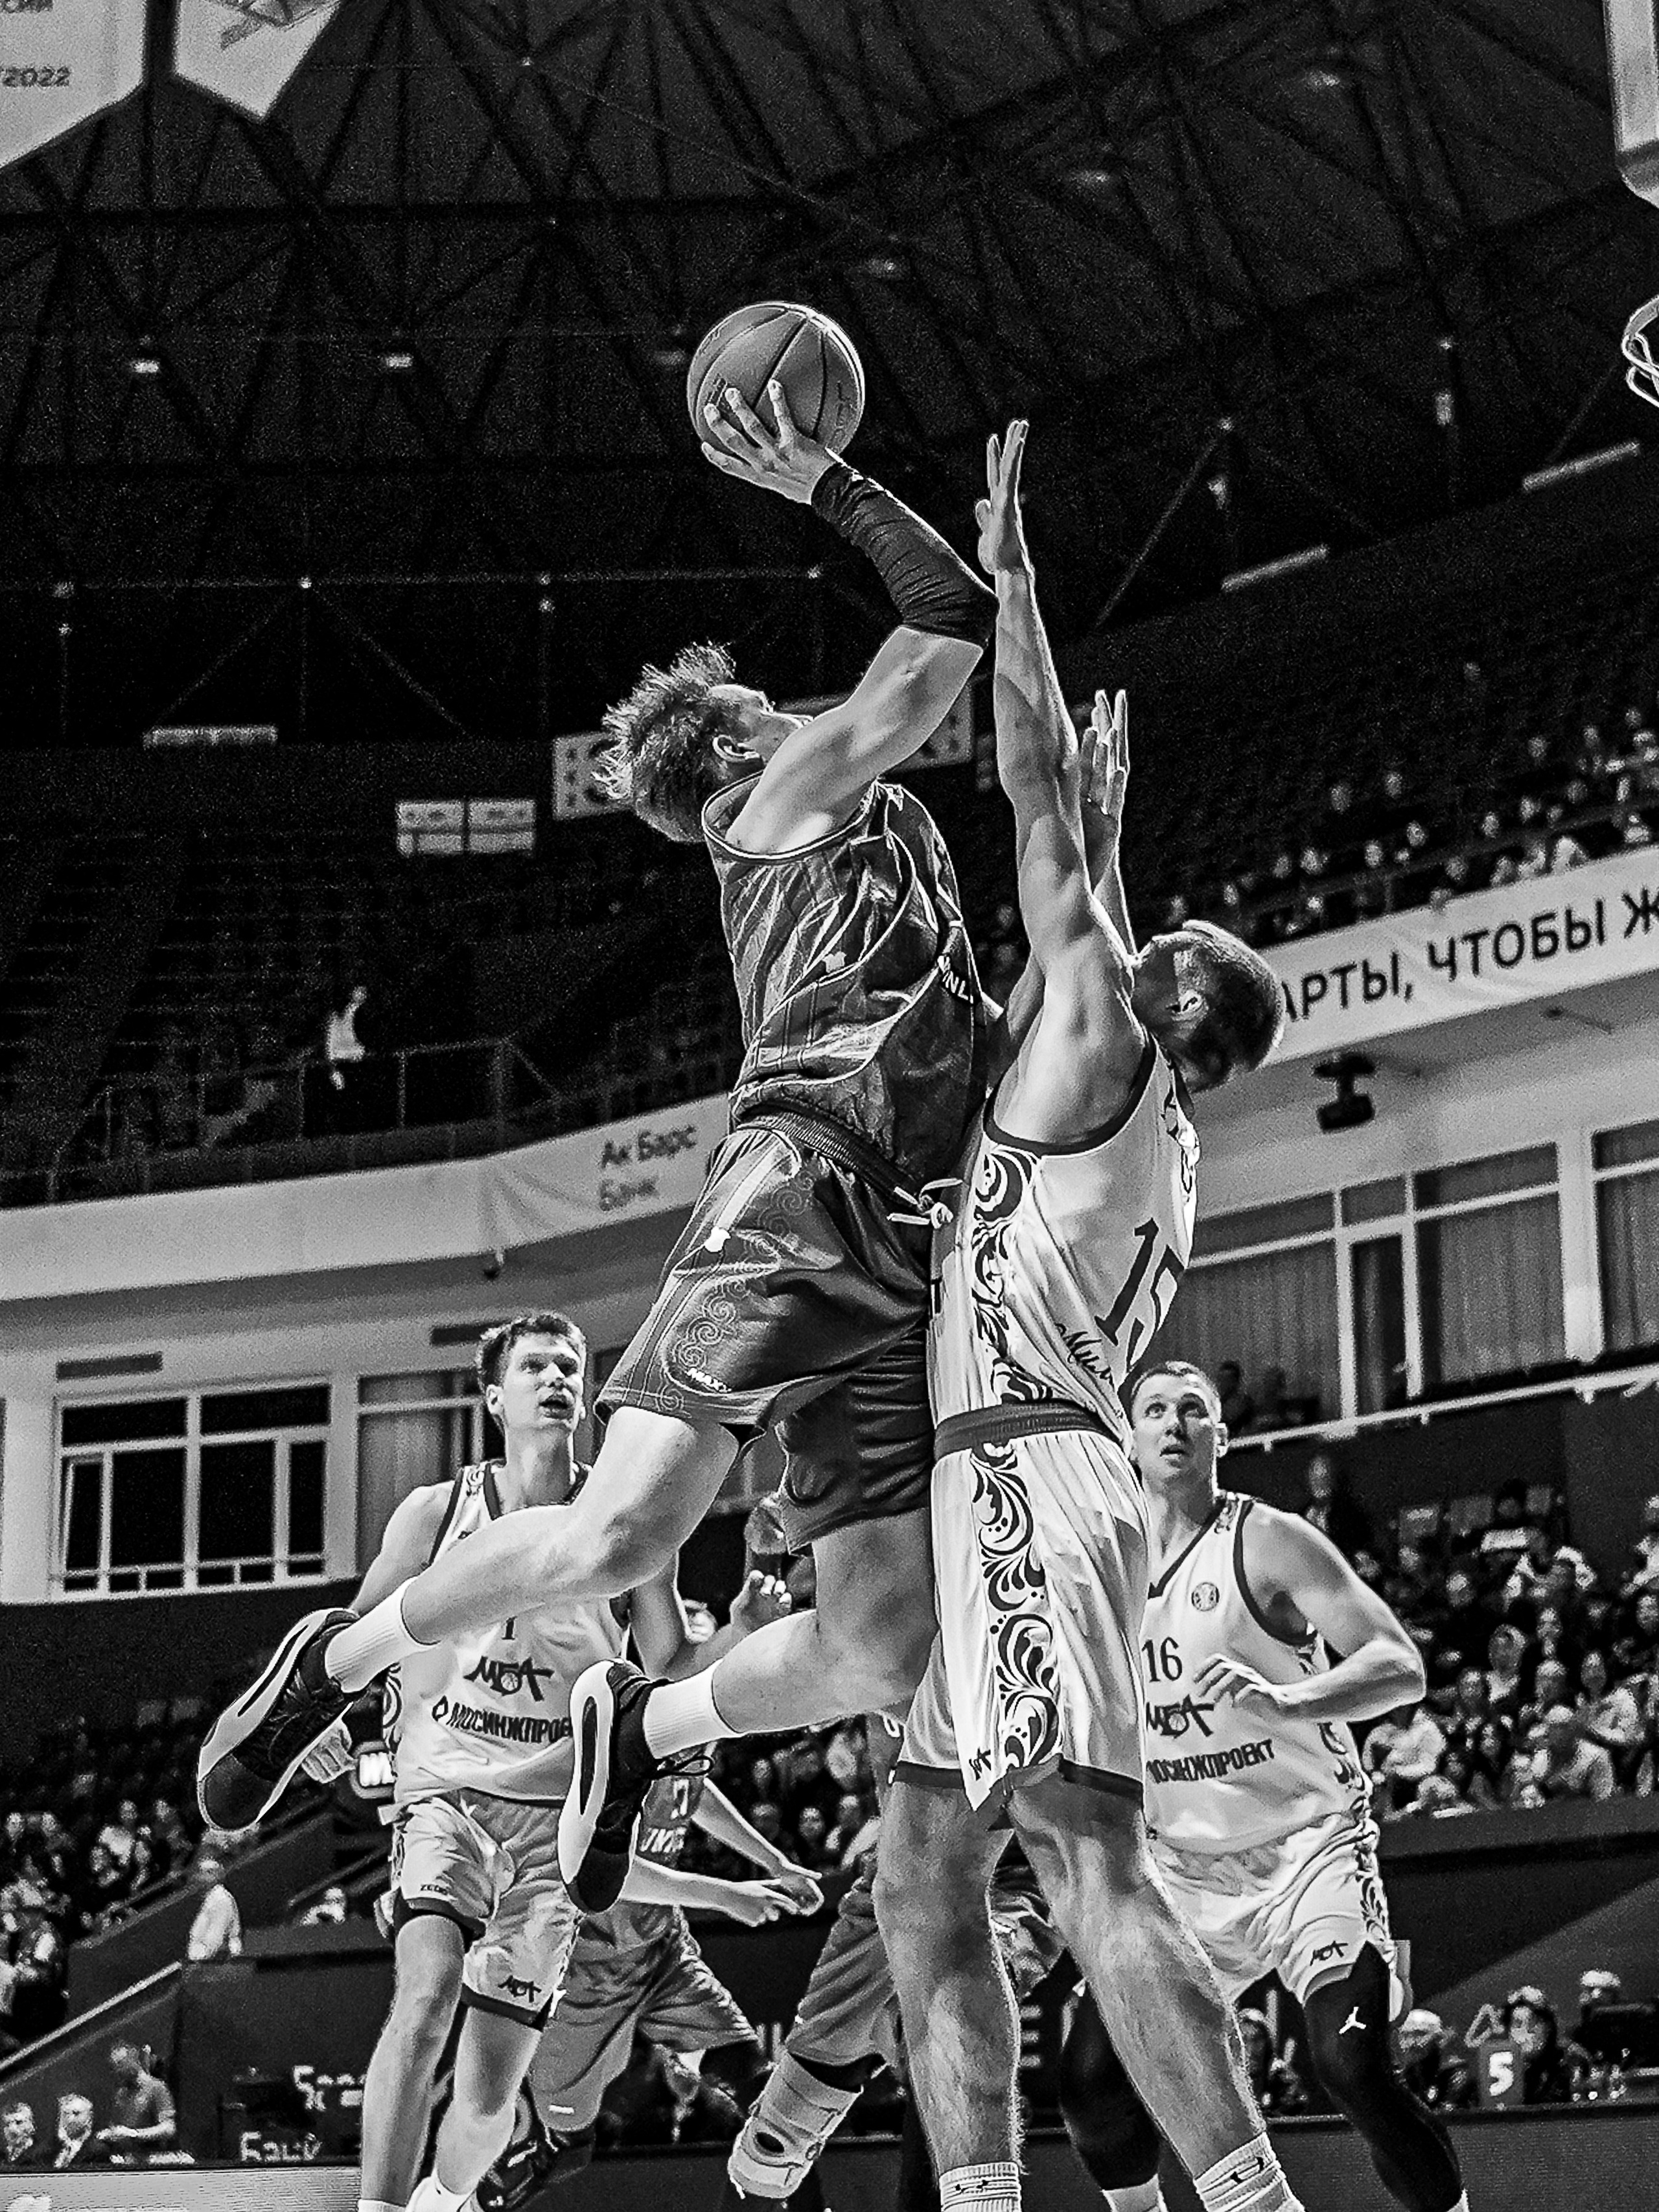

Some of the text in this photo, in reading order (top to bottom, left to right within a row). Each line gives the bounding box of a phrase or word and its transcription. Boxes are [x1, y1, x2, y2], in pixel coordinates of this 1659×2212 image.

[0, 67, 71, 87] 2022
[1427, 900, 1605, 980] ЧТОБЫ
[1141, 1636, 1183, 1683] 16
[445, 1702, 574, 1744] МОСИНЖПРОЕ
